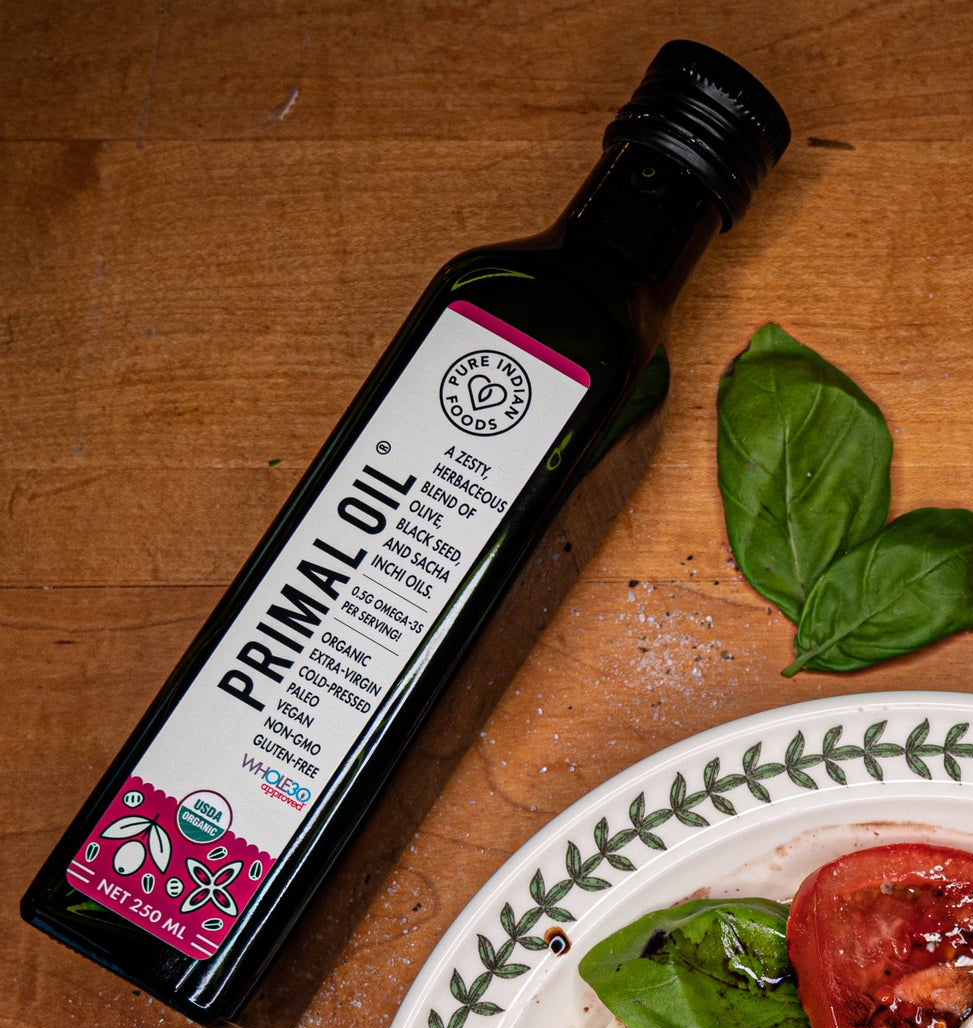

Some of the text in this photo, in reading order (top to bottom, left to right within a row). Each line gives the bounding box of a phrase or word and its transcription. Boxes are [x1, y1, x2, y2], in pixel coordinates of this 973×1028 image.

[448, 356, 525, 420] PURE INDIAN
[446, 395, 498, 431] FOODS
[444, 445, 492, 481] A ZESTY,
[420, 481, 477, 520] BLEND OF
[432, 462, 508, 513] HERBACEOUS
[409, 500, 444, 530] OLIVE,
[382, 537, 451, 584] AND SACHA
[396, 517, 462, 567] BLACK SEED,
[217, 538, 368, 712] PRIMAL
[337, 464, 417, 535] OIL
[351, 586, 373, 605] 0.5G
[370, 554, 433, 600] INCHI OILS.
[341, 601, 403, 643] PER SERVING!
[321, 632, 372, 667] ORGANIC
[298, 666, 372, 715] COLD-PRESSED
[308, 649, 382, 697] EXTRA-VIRGIN
[276, 699, 315, 728] VEGAN
[286, 682, 320, 708] PALEO
[253, 734, 320, 779] GLUTEN-FREE
[263, 716, 322, 756] NON-GMO
[241, 753, 312, 803] WHOLE30
[260, 783, 305, 811] approved
[181, 812, 218, 837] ORGANIC
[193, 799, 223, 823] USDA
[96, 878, 187, 940] NET 250 ML
